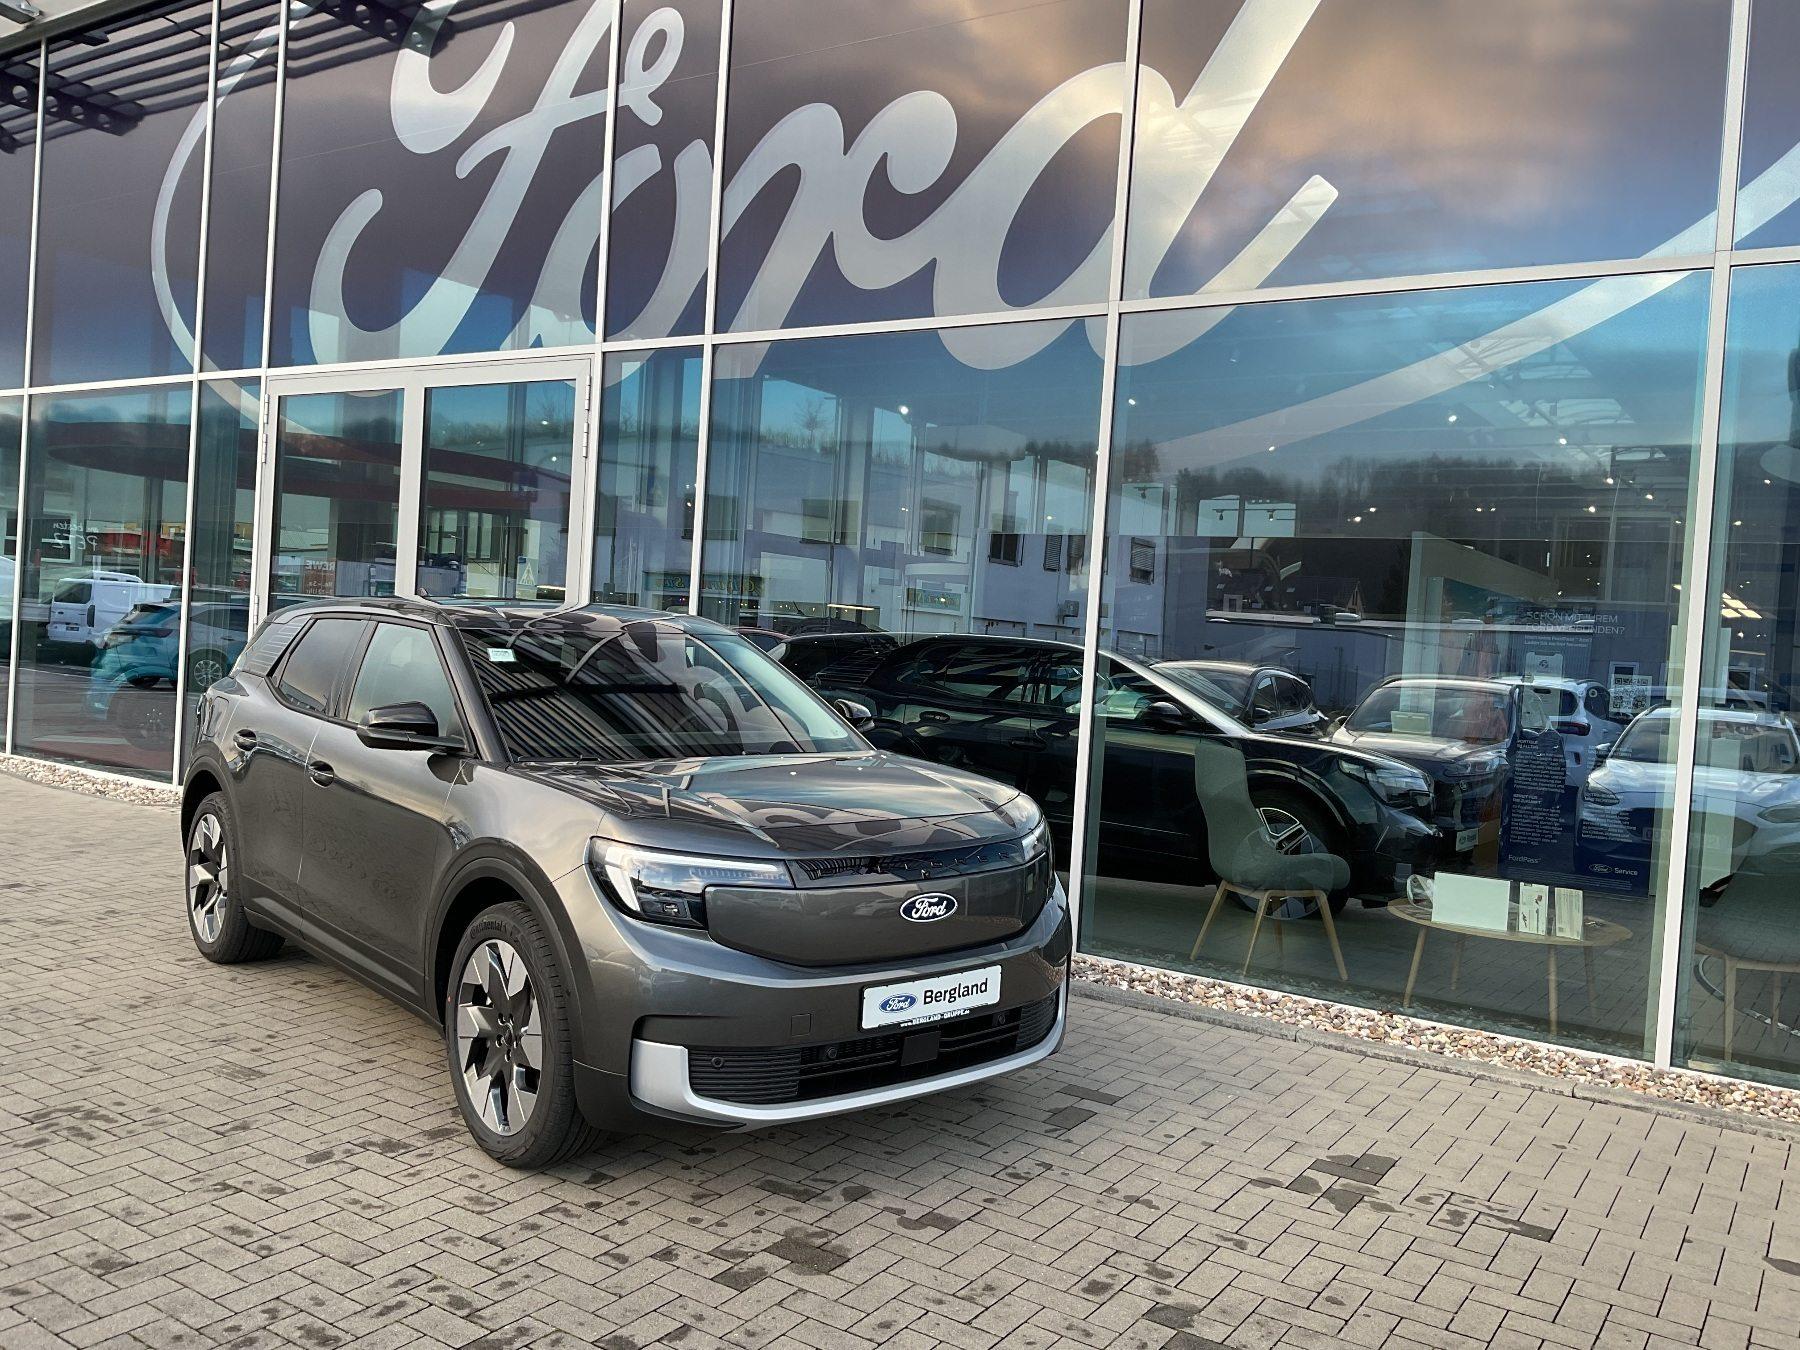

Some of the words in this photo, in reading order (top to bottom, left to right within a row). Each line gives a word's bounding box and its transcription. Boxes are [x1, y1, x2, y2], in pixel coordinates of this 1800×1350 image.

[309, 0, 1339, 397] Ford
[1614, 867, 1639, 877] Service
[912, 897, 947, 919] Ford
[886, 996, 911, 1011] Ford
[923, 977, 989, 1005] Bergland
